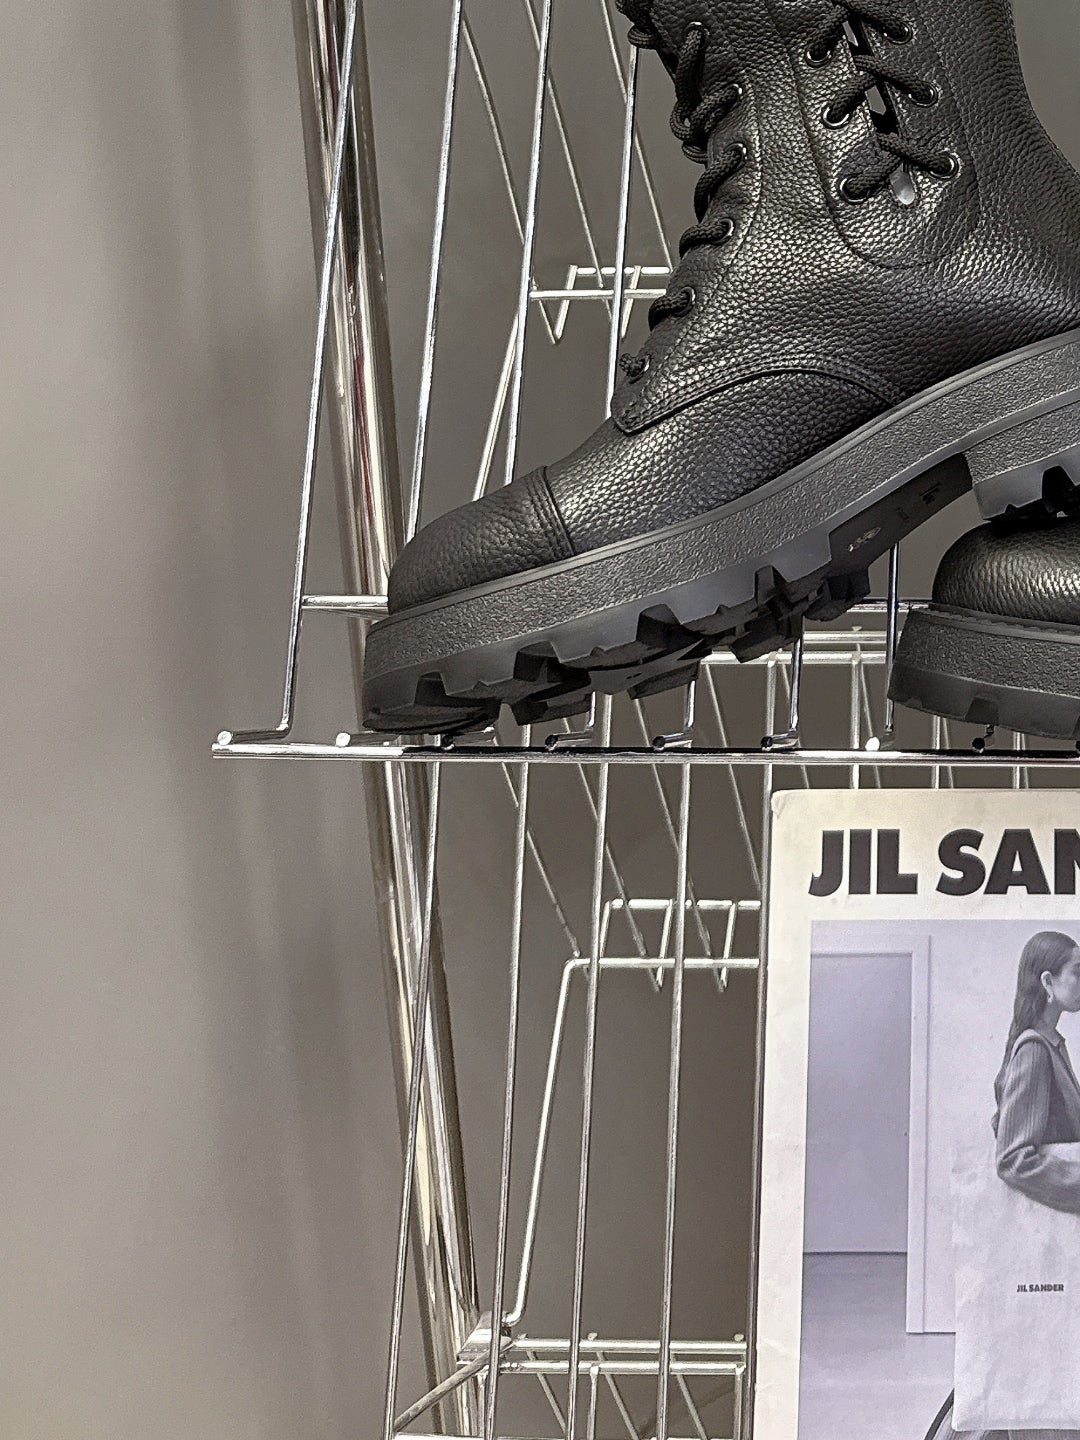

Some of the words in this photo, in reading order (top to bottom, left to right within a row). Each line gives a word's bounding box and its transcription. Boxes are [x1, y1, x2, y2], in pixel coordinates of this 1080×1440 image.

[808, 828, 918, 898] JIL
[1016, 1284, 1028, 1293] JIL
[1029, 1283, 1064, 1292] SANDER
